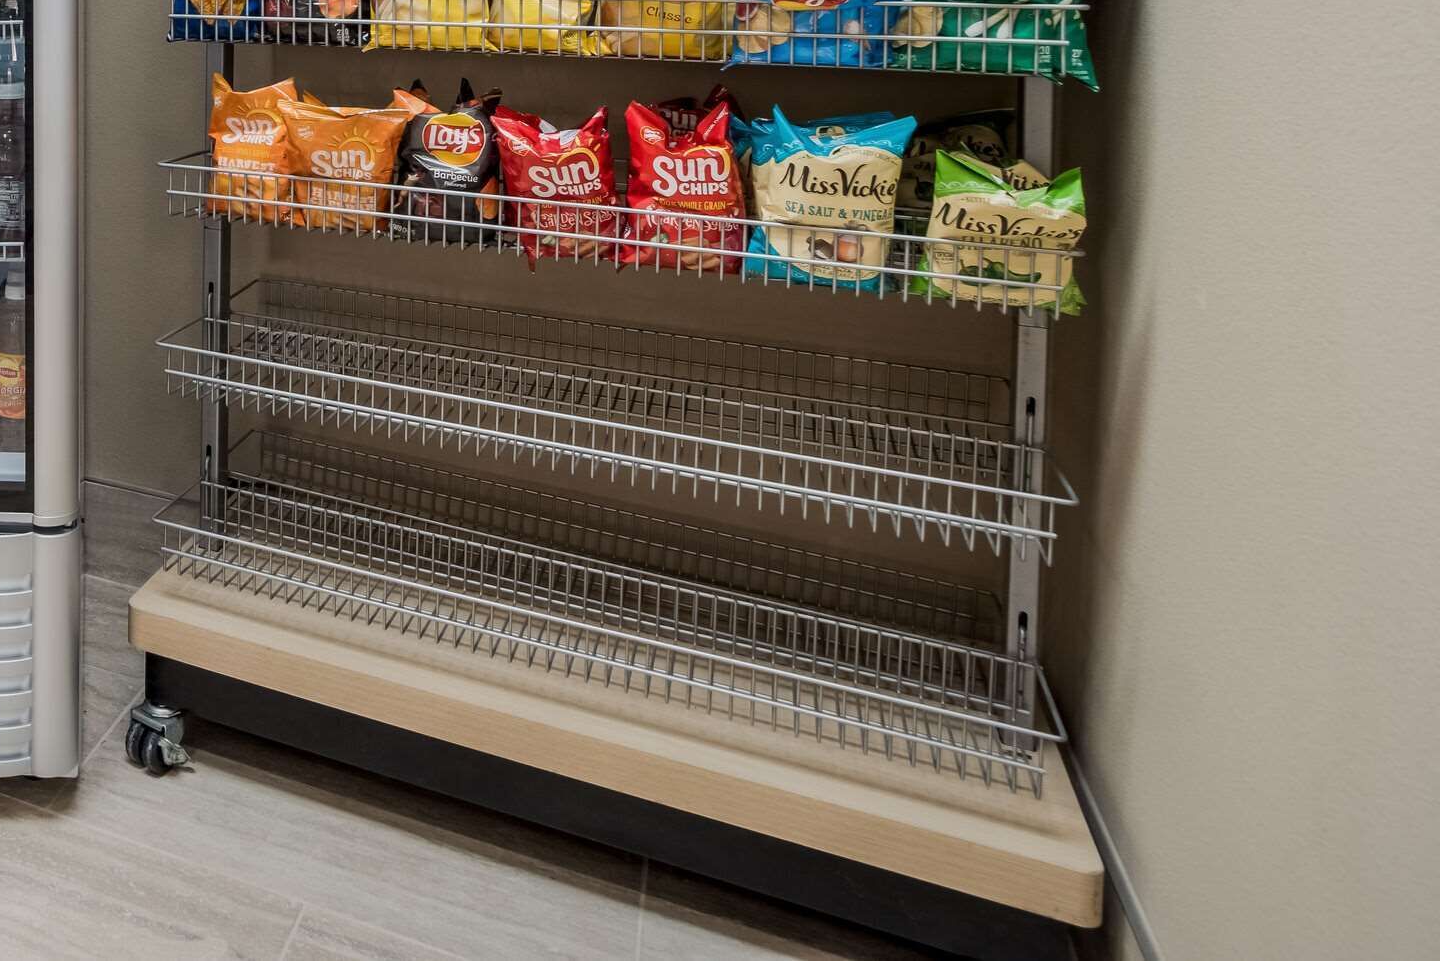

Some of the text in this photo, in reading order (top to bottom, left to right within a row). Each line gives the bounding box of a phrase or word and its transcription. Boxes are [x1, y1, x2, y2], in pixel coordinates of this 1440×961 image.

[222, 117, 282, 144] Sun
[239, 133, 274, 146] CHIPS
[428, 124, 481, 154] Lay's
[311, 149, 376, 179] Sun
[333, 168, 373, 181] CHIPS
[433, 169, 478, 183] Barbecue
[528, 160, 599, 198] Sun
[558, 178, 602, 196] CHIPS
[652, 155, 731, 197] Sun
[780, 162, 898, 205] Miss Vickie'
[679, 181, 729, 196] CHIPS
[703, 200, 727, 211] GRAIN
[785, 200, 806, 215] SEA
[808, 205, 836, 218] SALT
[838, 209, 848, 219] &
[935, 202, 997, 236] Miss
